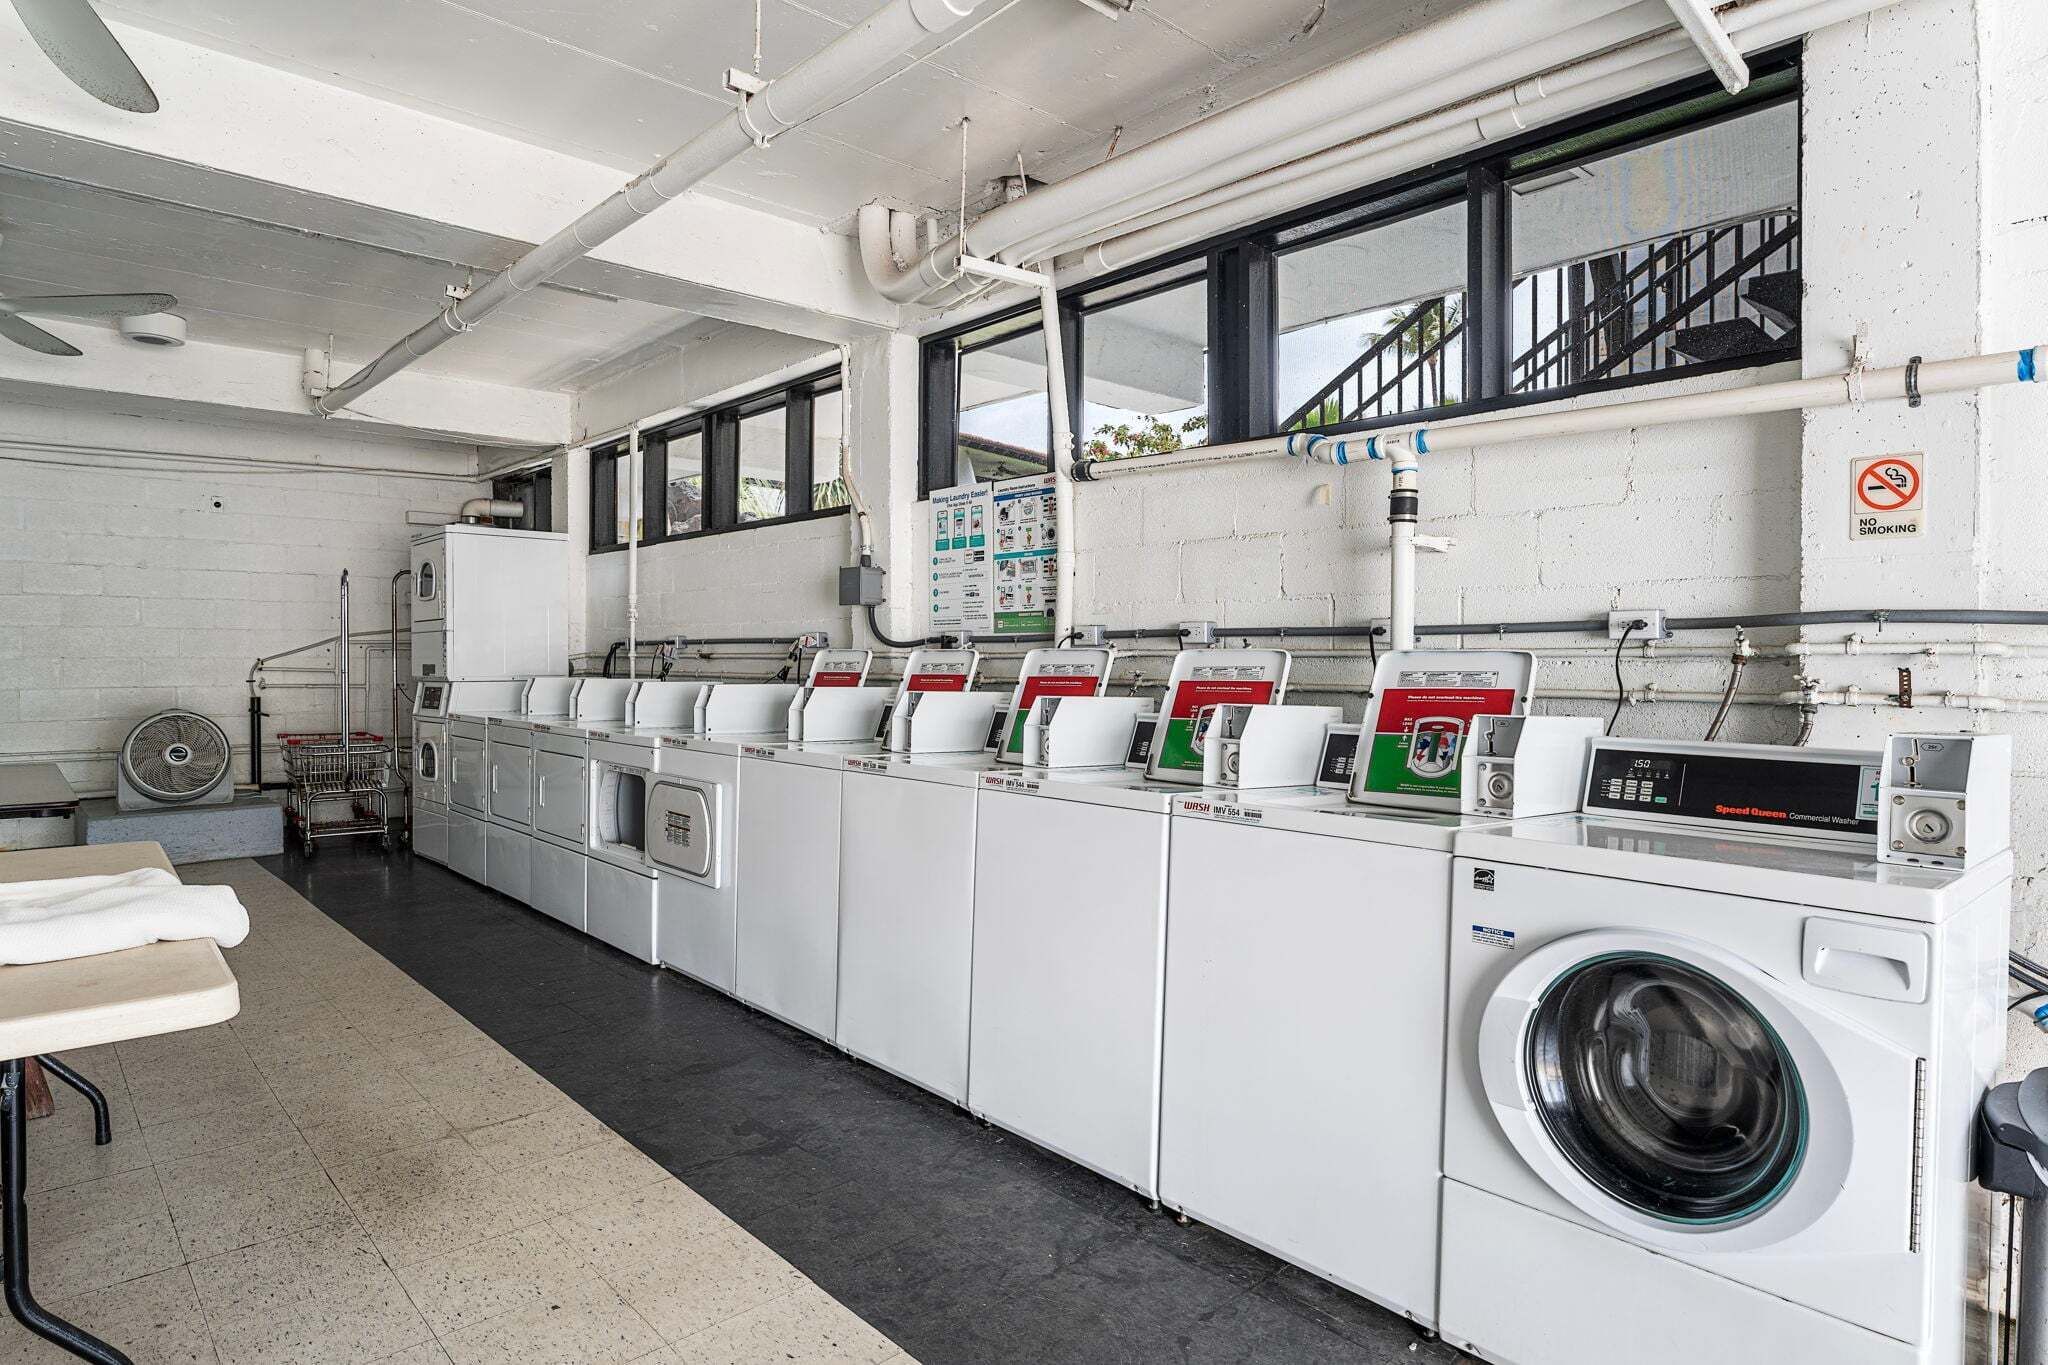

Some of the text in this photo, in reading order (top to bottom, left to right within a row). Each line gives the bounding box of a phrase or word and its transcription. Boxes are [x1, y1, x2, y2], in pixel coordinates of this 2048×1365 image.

[1043, 476, 1056, 484] WAS
[932, 496, 949, 504] Making
[950, 493, 970, 502] Laundry
[1859, 518, 1877, 527] NO
[1859, 524, 1917, 535] SMOKING
[985, 776, 1004, 785] WASH
[1184, 801, 1210, 812] WASH
[1213, 806, 1226, 814] IMV
[1227, 808, 1240, 816] 554
[1715, 804, 1859, 826] Speed Queen Commercial Washer
